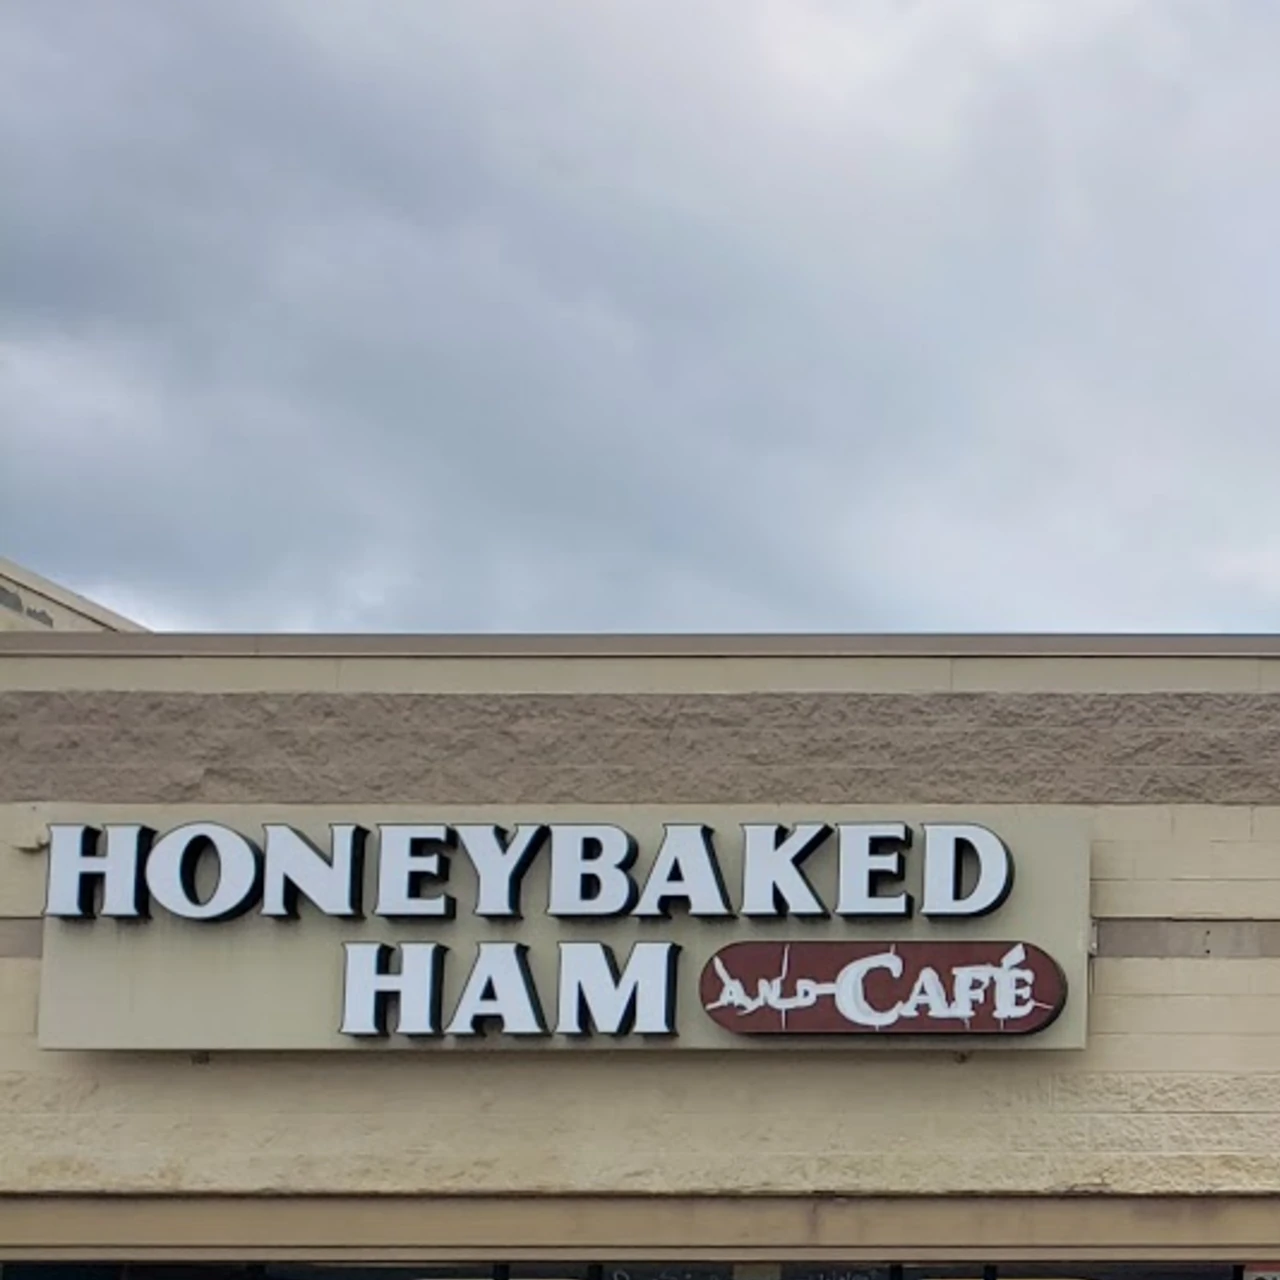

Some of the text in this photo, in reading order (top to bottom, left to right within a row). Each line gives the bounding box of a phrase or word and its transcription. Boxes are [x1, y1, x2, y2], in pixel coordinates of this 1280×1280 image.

[44, 822, 1012, 920] HONEYBAKED
[338, 942, 1036, 1037] HAM AND CAFÉ
